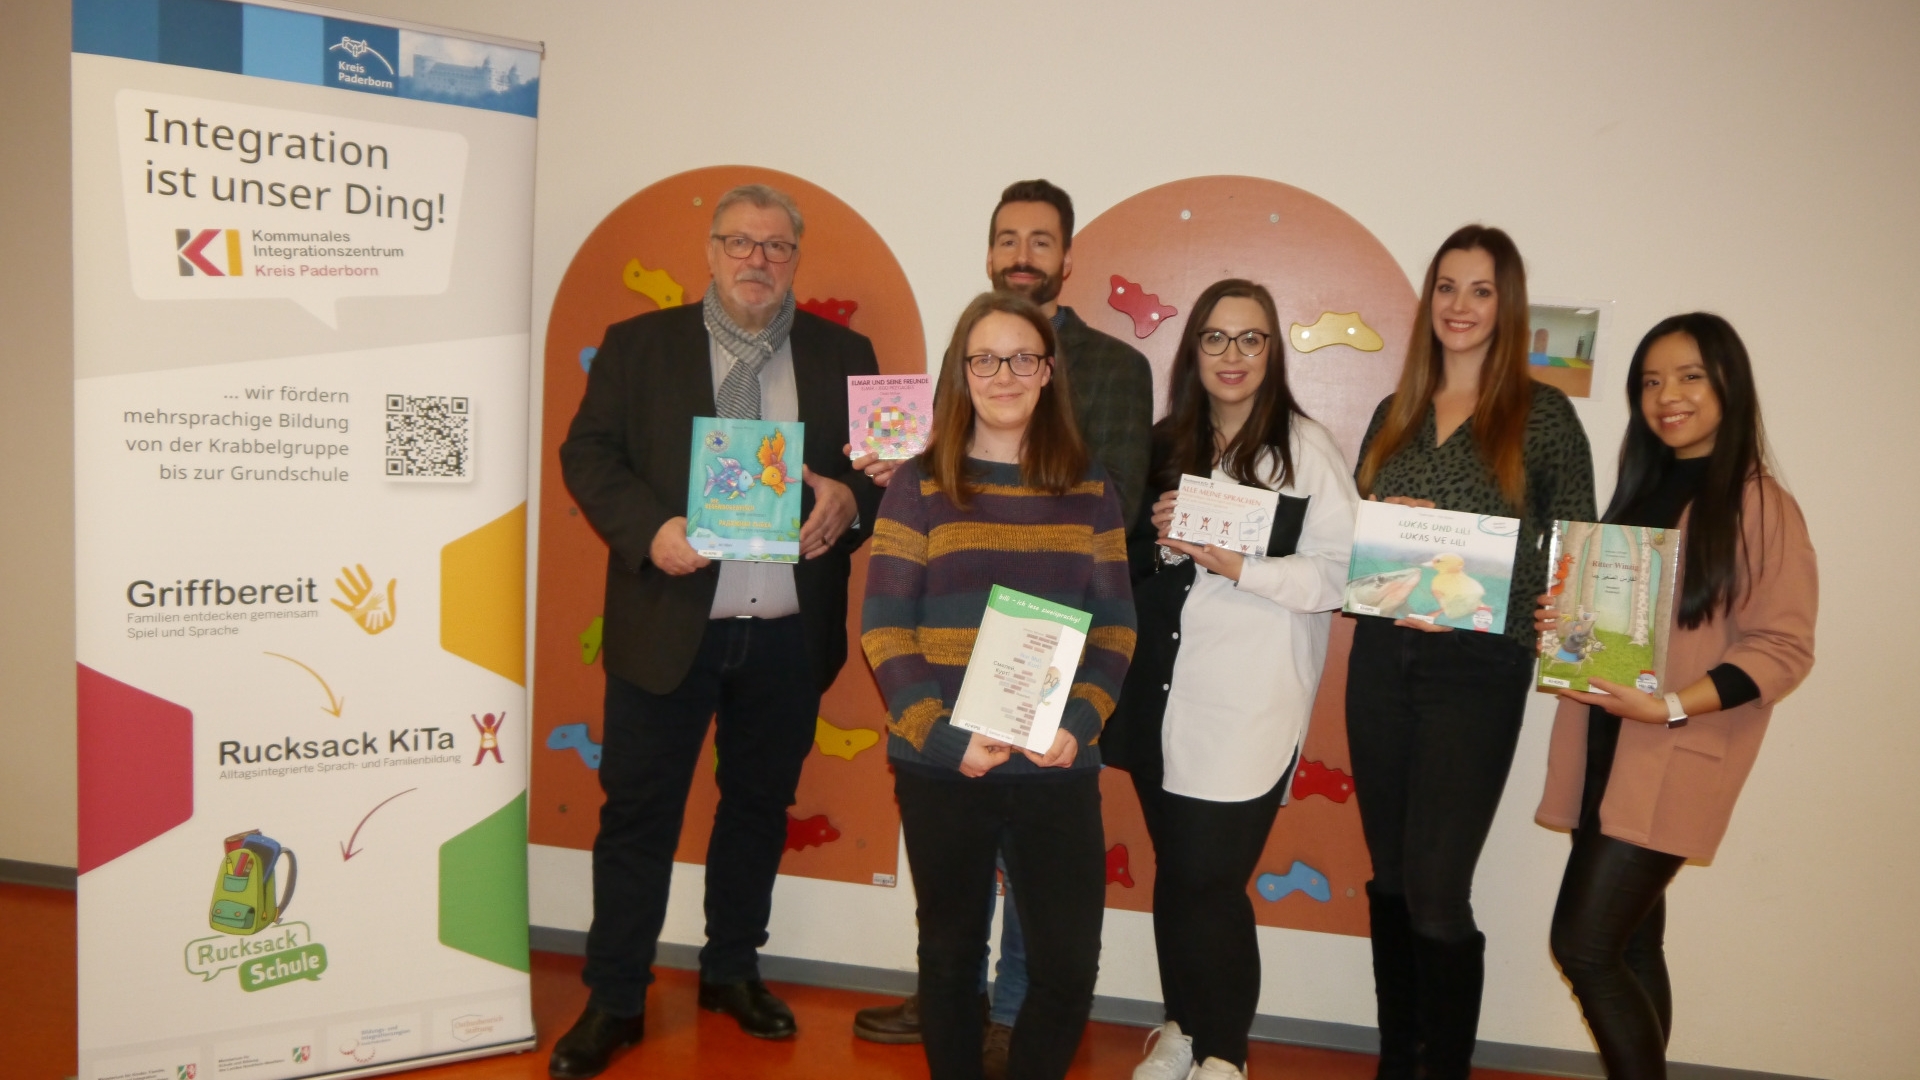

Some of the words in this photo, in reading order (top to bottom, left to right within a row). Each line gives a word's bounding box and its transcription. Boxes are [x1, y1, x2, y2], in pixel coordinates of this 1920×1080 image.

[338, 61, 365, 73] Kreis
[338, 72, 393, 89] Paderborn
[144, 108, 389, 170] Integration
[146, 160, 197, 199] ist
[211, 175, 331, 209] unser
[346, 183, 445, 231] Ding!
[252, 230, 351, 244] Kommunales
[175, 228, 243, 277] KI
[253, 245, 404, 260] Integrationszentrum
[255, 264, 296, 277] Kreis
[300, 264, 379, 277] Paderborn
[245, 386, 276, 401] wir
[280, 386, 349, 404] fördern
[123, 408, 273, 431] mehrsprachige
[279, 412, 349, 433] Bildung
[126, 439, 163, 453] von
[169, 436, 202, 454] der
[209, 437, 349, 460] Krabbelgruppe
[160, 463, 188, 480] bis
[194, 467, 224, 481] zur
[230, 464, 349, 483] Grundschule
[1182, 485, 1197, 494] ALLE
[1200, 489, 1222, 499] MEINE
[1224, 493, 1261, 506] SPRACHEN
[1399, 520, 1428, 530] LUKAS
[1432, 523, 1452, 533] UND
[1455, 527, 1471, 535] LILI
[1400, 532, 1429, 542] LUKAS
[1434, 535, 1447, 544] VE
[1450, 539, 1466, 547] LILI
[1592, 560, 1613, 568] Ritter
[126, 577, 319, 609] Griffbereit
[127, 611, 180, 624] Familien
[183, 609, 247, 622] entdecken
[250, 608, 318, 623] gemeinsam
[1028, 603, 1039, 611] lese
[127, 627, 158, 640] Spiel
[161, 626, 185, 638] und
[188, 625, 239, 639] Sprache
[219, 732, 377, 766] Rucksack
[389, 727, 455, 754] KiTa
[219, 763, 314, 781] Alltagsintegrierte
[317, 760, 358, 774] Sprach-
[361, 757, 381, 770] und
[383, 752, 462, 770] Familienbildung
[198, 930, 298, 965] Rucksack
[250, 951, 320, 986] Schule
